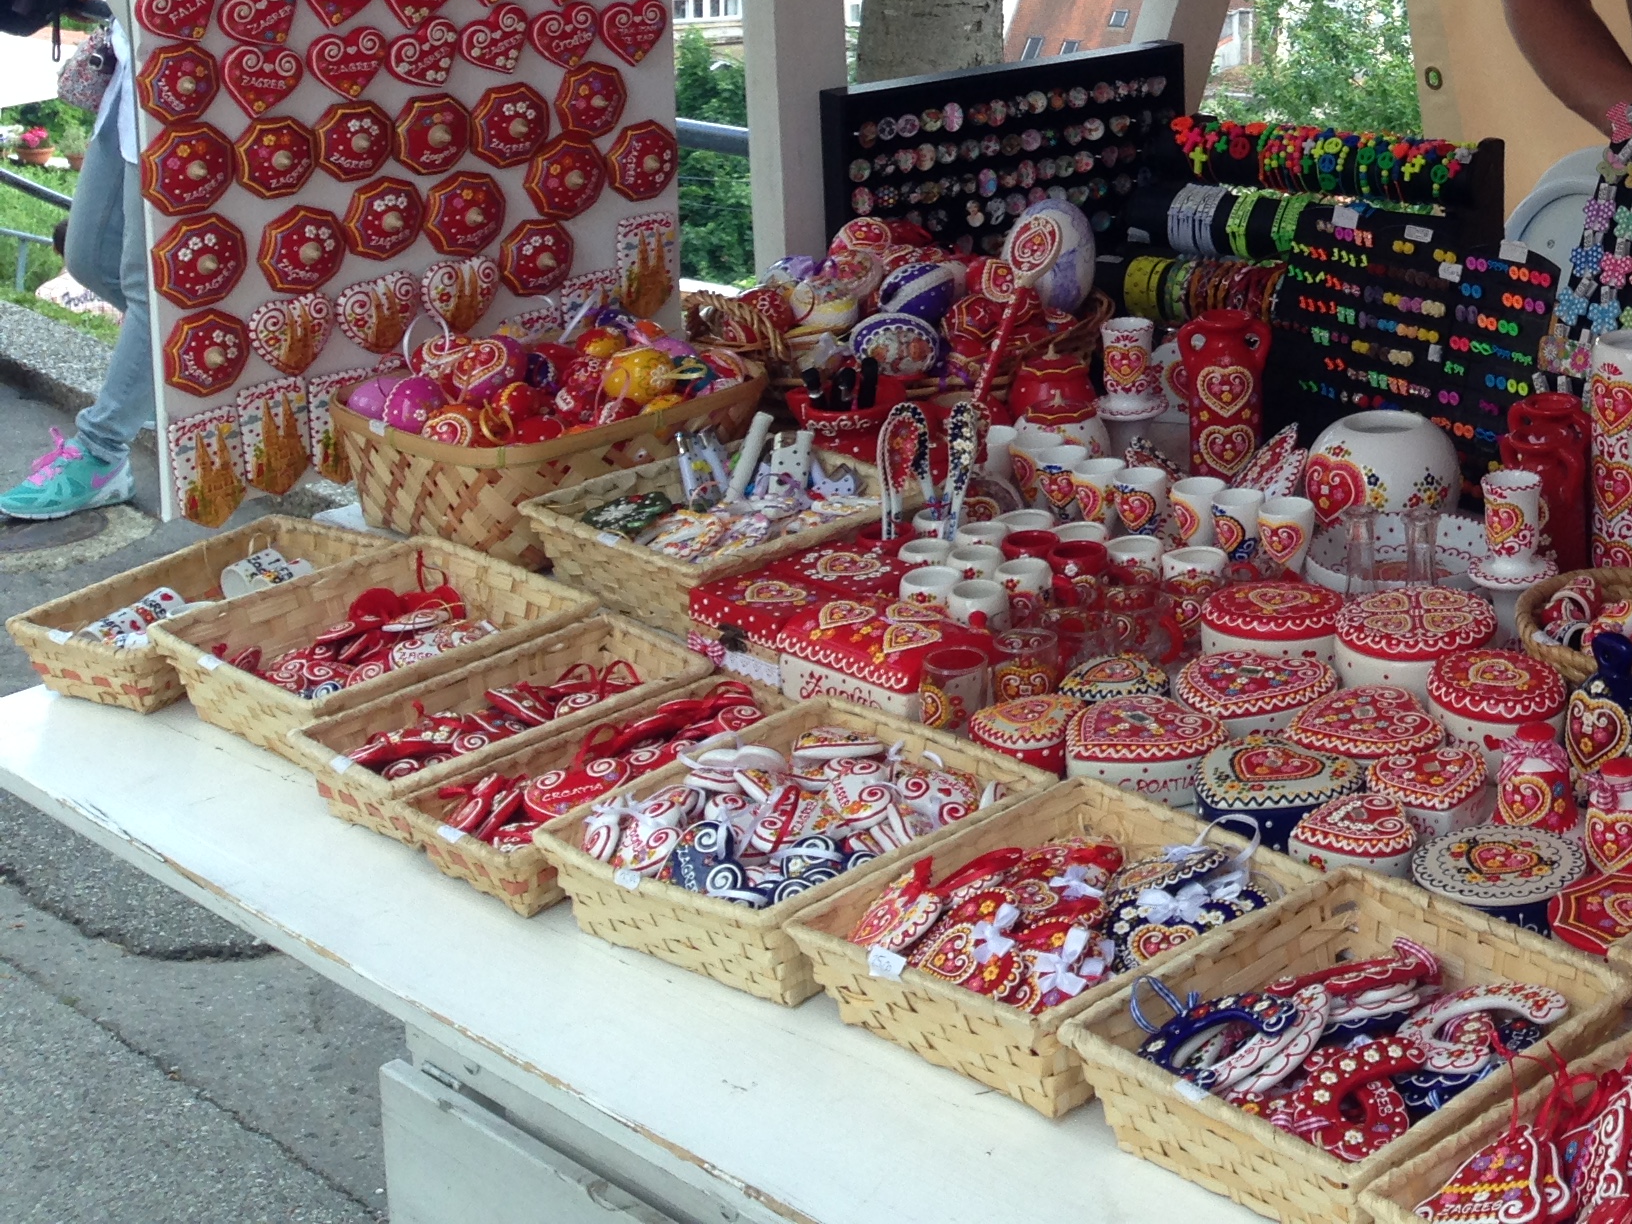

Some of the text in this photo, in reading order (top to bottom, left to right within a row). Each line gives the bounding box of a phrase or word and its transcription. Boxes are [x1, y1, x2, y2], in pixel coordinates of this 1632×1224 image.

[246, 5, 293, 36] ZAGREB
[157, 79, 185, 112] ZAGREB
[240, 75, 287, 91] ZAGREB
[329, 152, 374, 170] ZAGREB
[490, 139, 531, 156] ZAGREB
[183, 172, 224, 202] ZAGREB
[270, 158, 311, 188] ZAGREB
[196, 260, 237, 296] ZAGREB
[278, 259, 320, 282] ZAGREB
[245, 379, 303, 410] Zagreb
[174, 412, 237, 446] Zagreb
[542, 781, 604, 803] CROATIA
[676, 844, 699, 893] ZAGRE
[1436, 1200, 1503, 1217] ZAGREB
